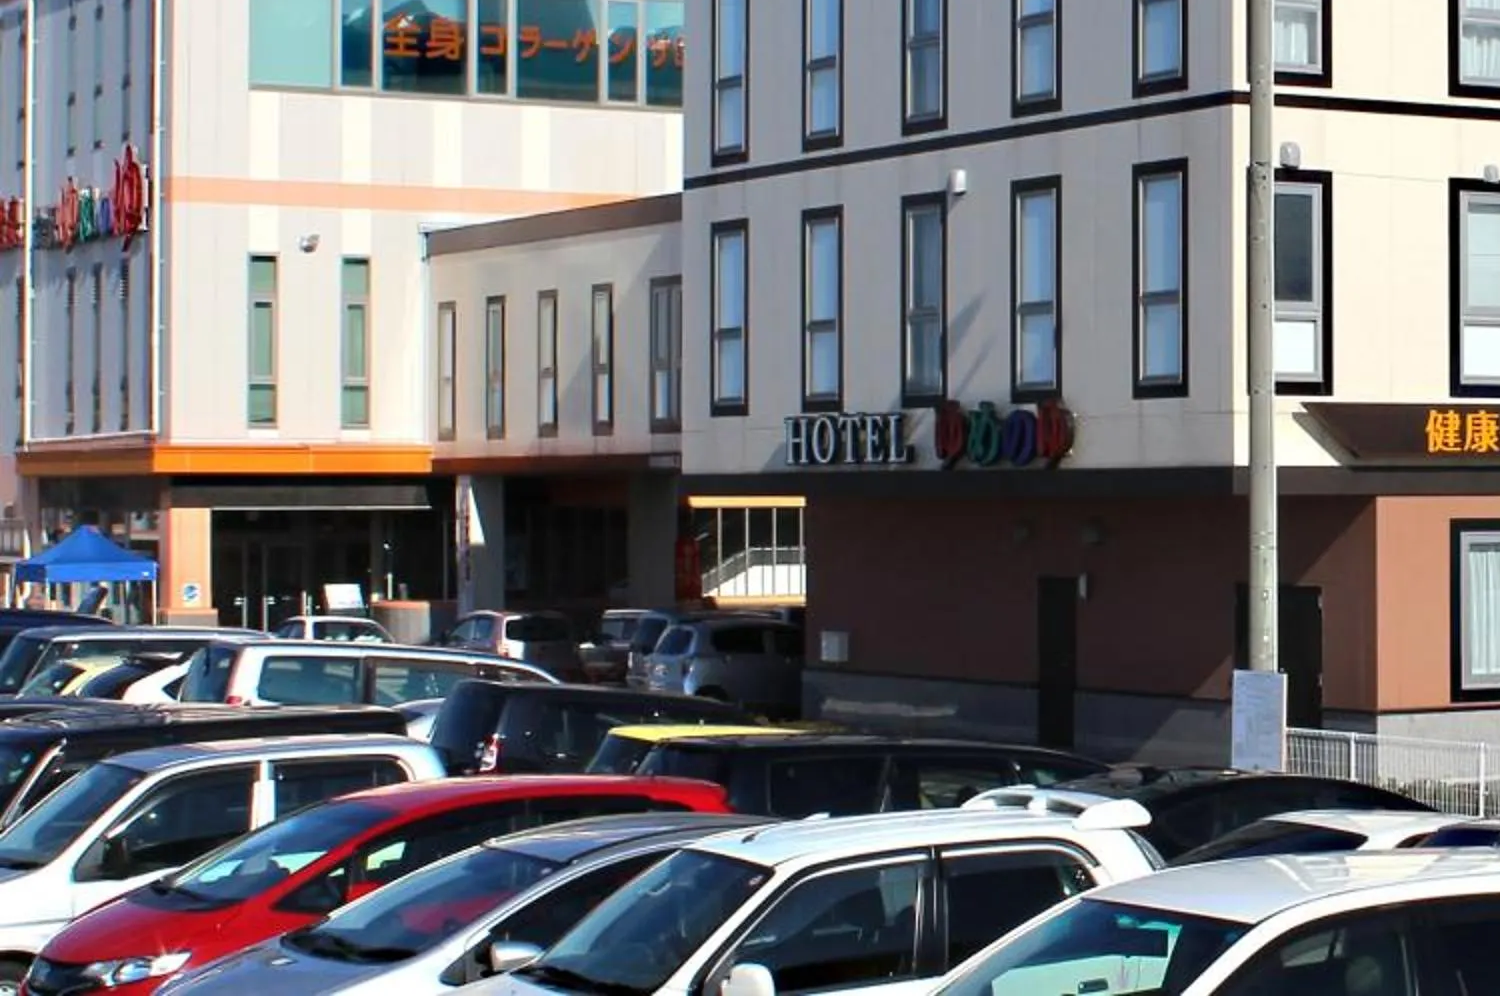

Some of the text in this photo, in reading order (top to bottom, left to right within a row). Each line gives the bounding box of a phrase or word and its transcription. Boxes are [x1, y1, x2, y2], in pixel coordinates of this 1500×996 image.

[784, 399, 1077, 469] HOTEL ゆめのゆ
